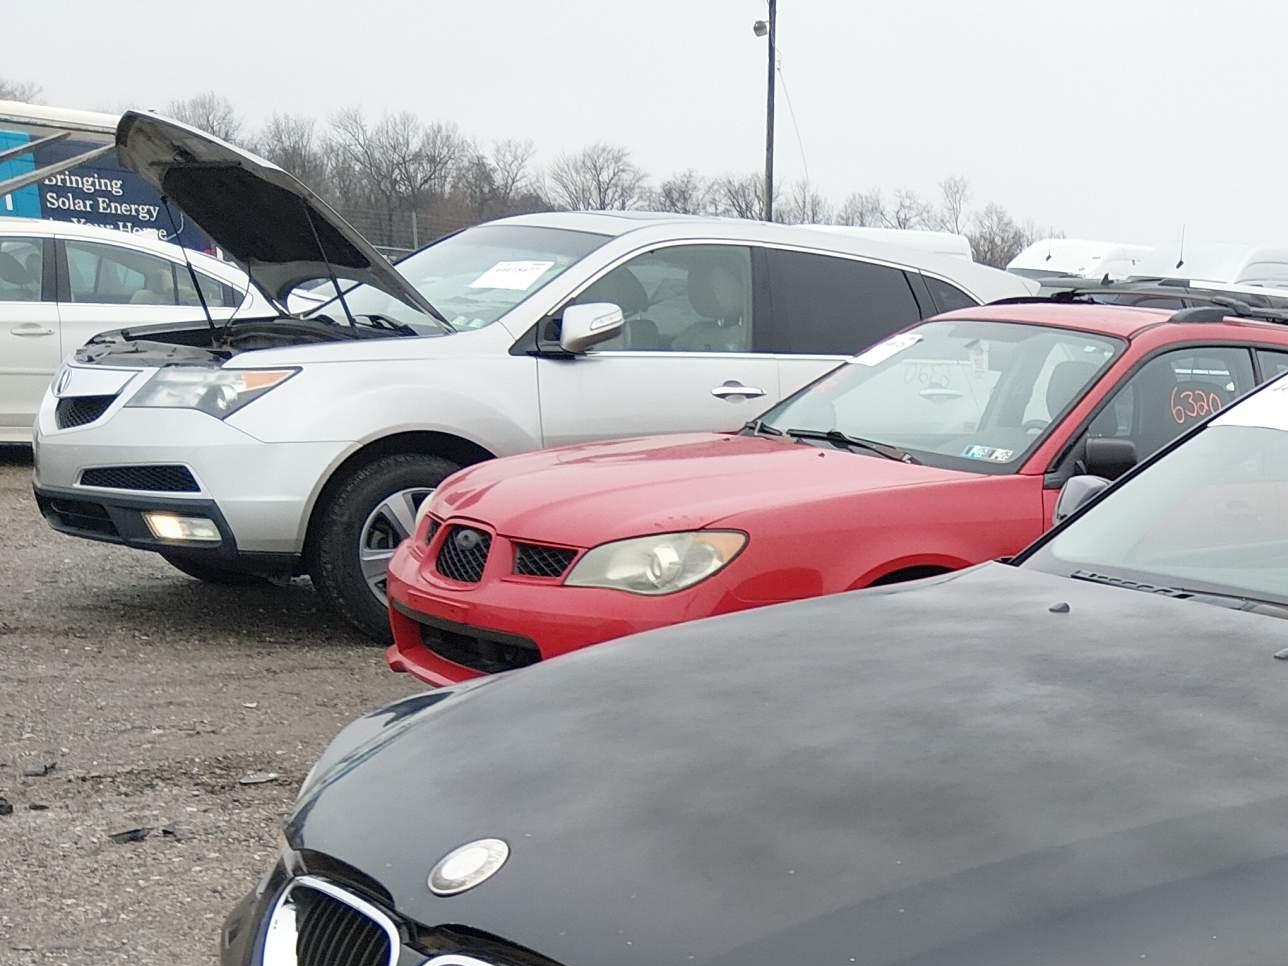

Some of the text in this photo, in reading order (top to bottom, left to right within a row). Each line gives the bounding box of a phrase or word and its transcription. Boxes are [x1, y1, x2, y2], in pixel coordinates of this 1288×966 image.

[46, 192, 160, 221] Solar Energy
[1170, 386, 1222, 424] 6320
